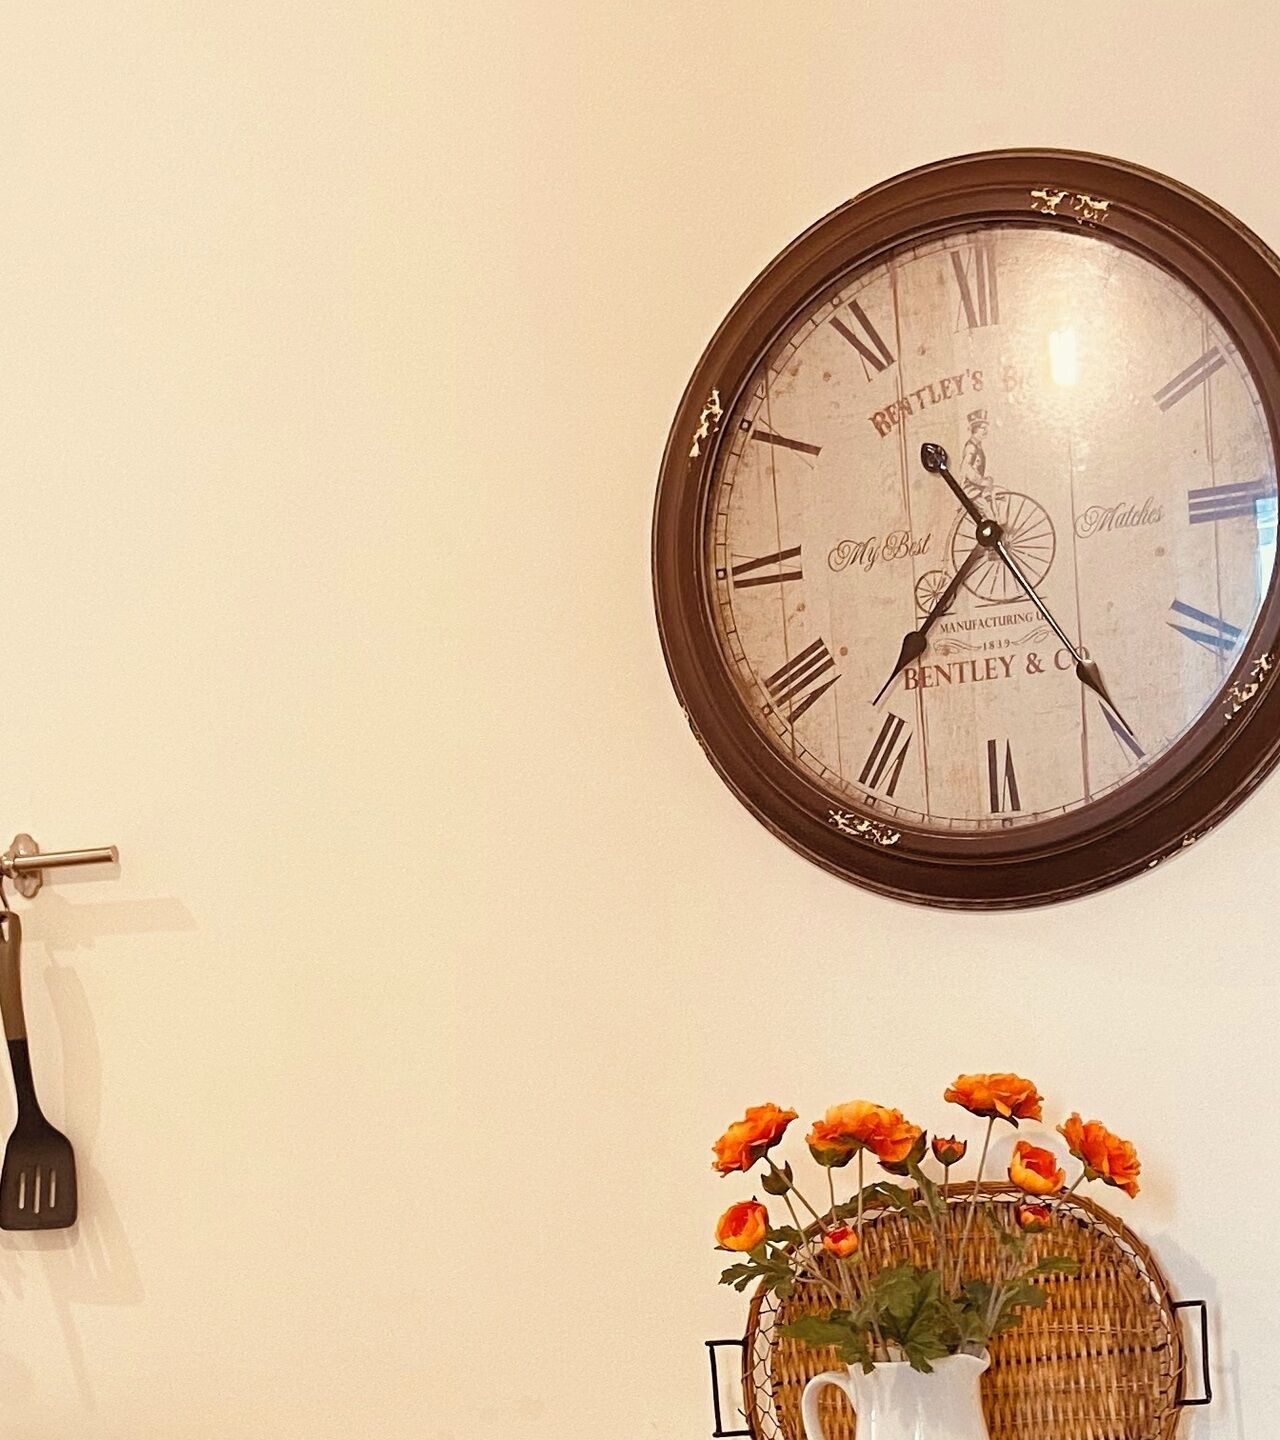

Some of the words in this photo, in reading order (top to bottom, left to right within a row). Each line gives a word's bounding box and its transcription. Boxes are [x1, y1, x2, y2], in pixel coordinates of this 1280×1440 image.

[949, 242, 1000, 334] XII
[829, 299, 897, 382] XI
[868, 369, 983, 438] BENTLEY'S
[1152, 346, 1227, 412] II
[828, 536, 880, 572] My
[882, 530, 931, 561] Best
[1074, 496, 1164, 539] Matches
[1188, 480, 1265, 524] III
[731, 544, 803, 589] IX
[939, 612, 1034, 633] MANUFACTURING
[983, 639, 1011, 651] 1839
[764, 636, 842, 725] VIII
[904, 654, 1016, 690] BENTLEY
[1026, 652, 1046, 674] &
[858, 711, 913, 798] VII
[987, 738, 1021, 814] VI
